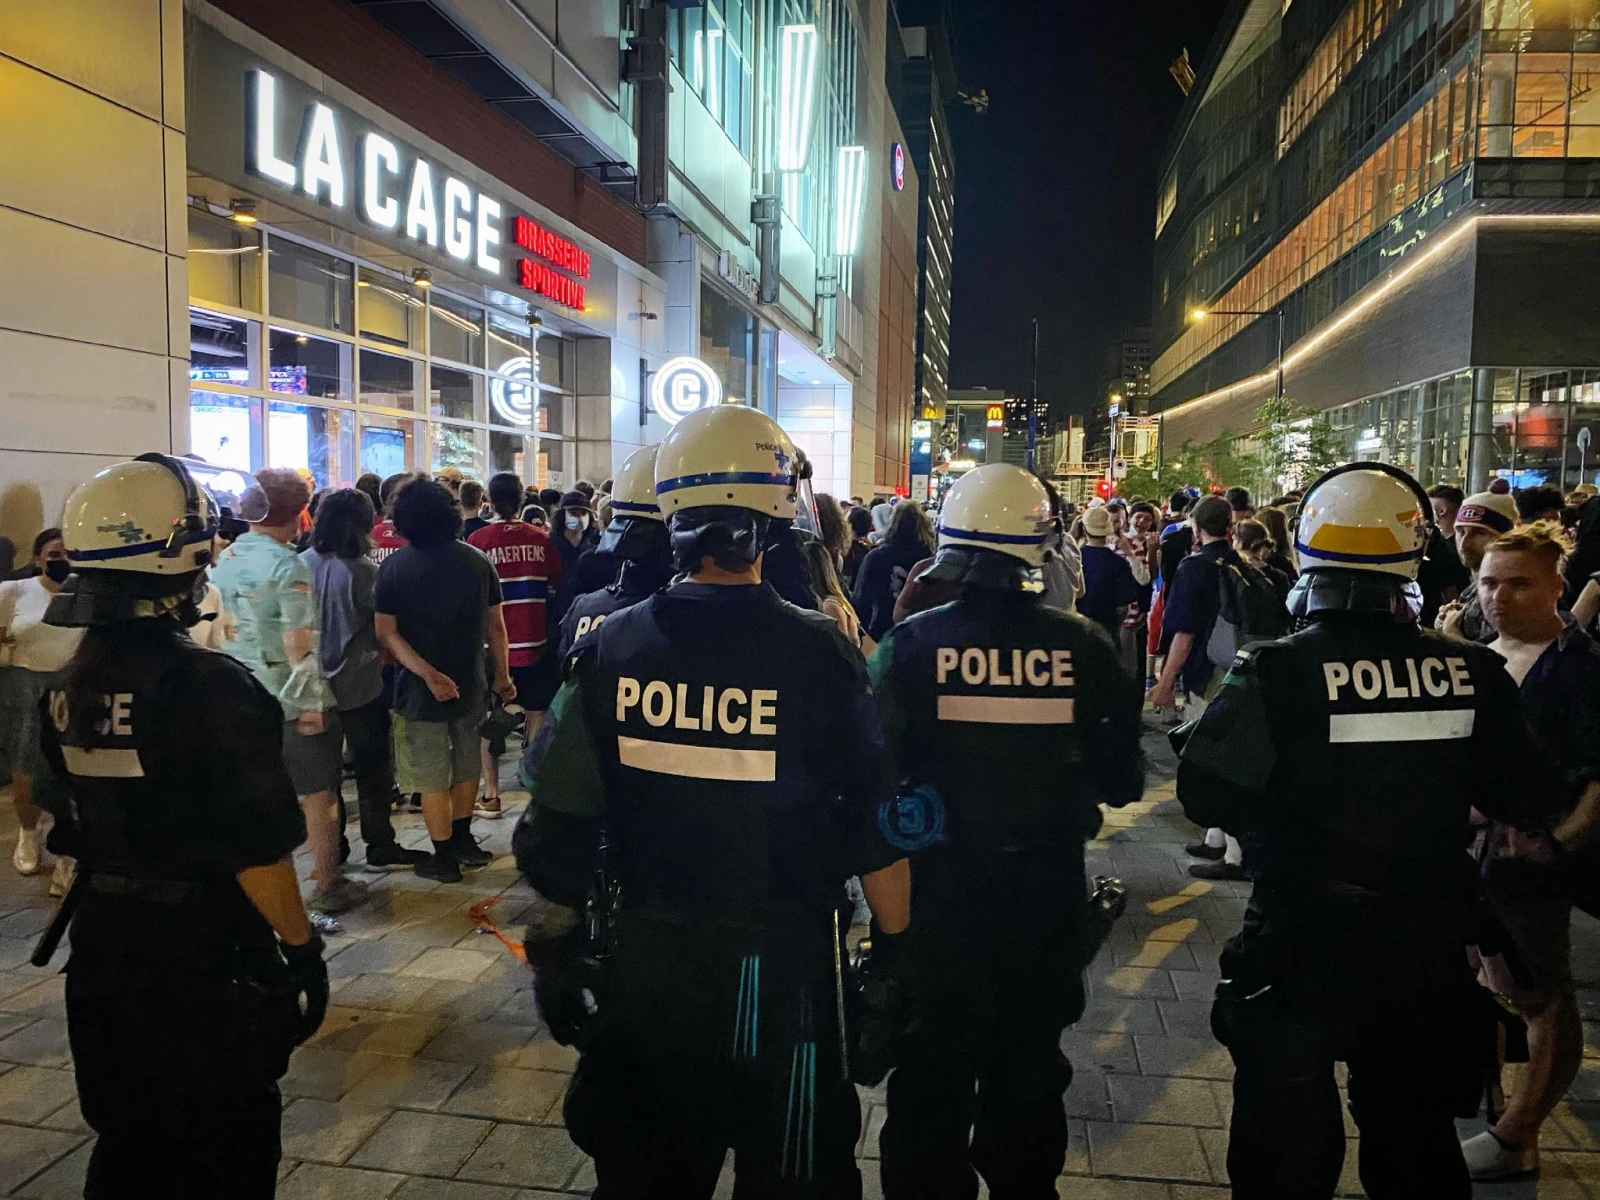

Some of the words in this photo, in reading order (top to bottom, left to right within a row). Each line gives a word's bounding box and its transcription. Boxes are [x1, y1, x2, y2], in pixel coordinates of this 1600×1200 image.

[254, 69, 344, 207] LA
[363, 130, 502, 275] CAGE
[517, 215, 590, 280] BRASSERIE
[522, 258, 586, 312] SPORTIVE
[486, 545, 546, 565] MAERTENS
[936, 647, 1075, 687] POLICE
[1322, 656, 1475, 701] POLICE
[616, 676, 778, 736] POLICE
